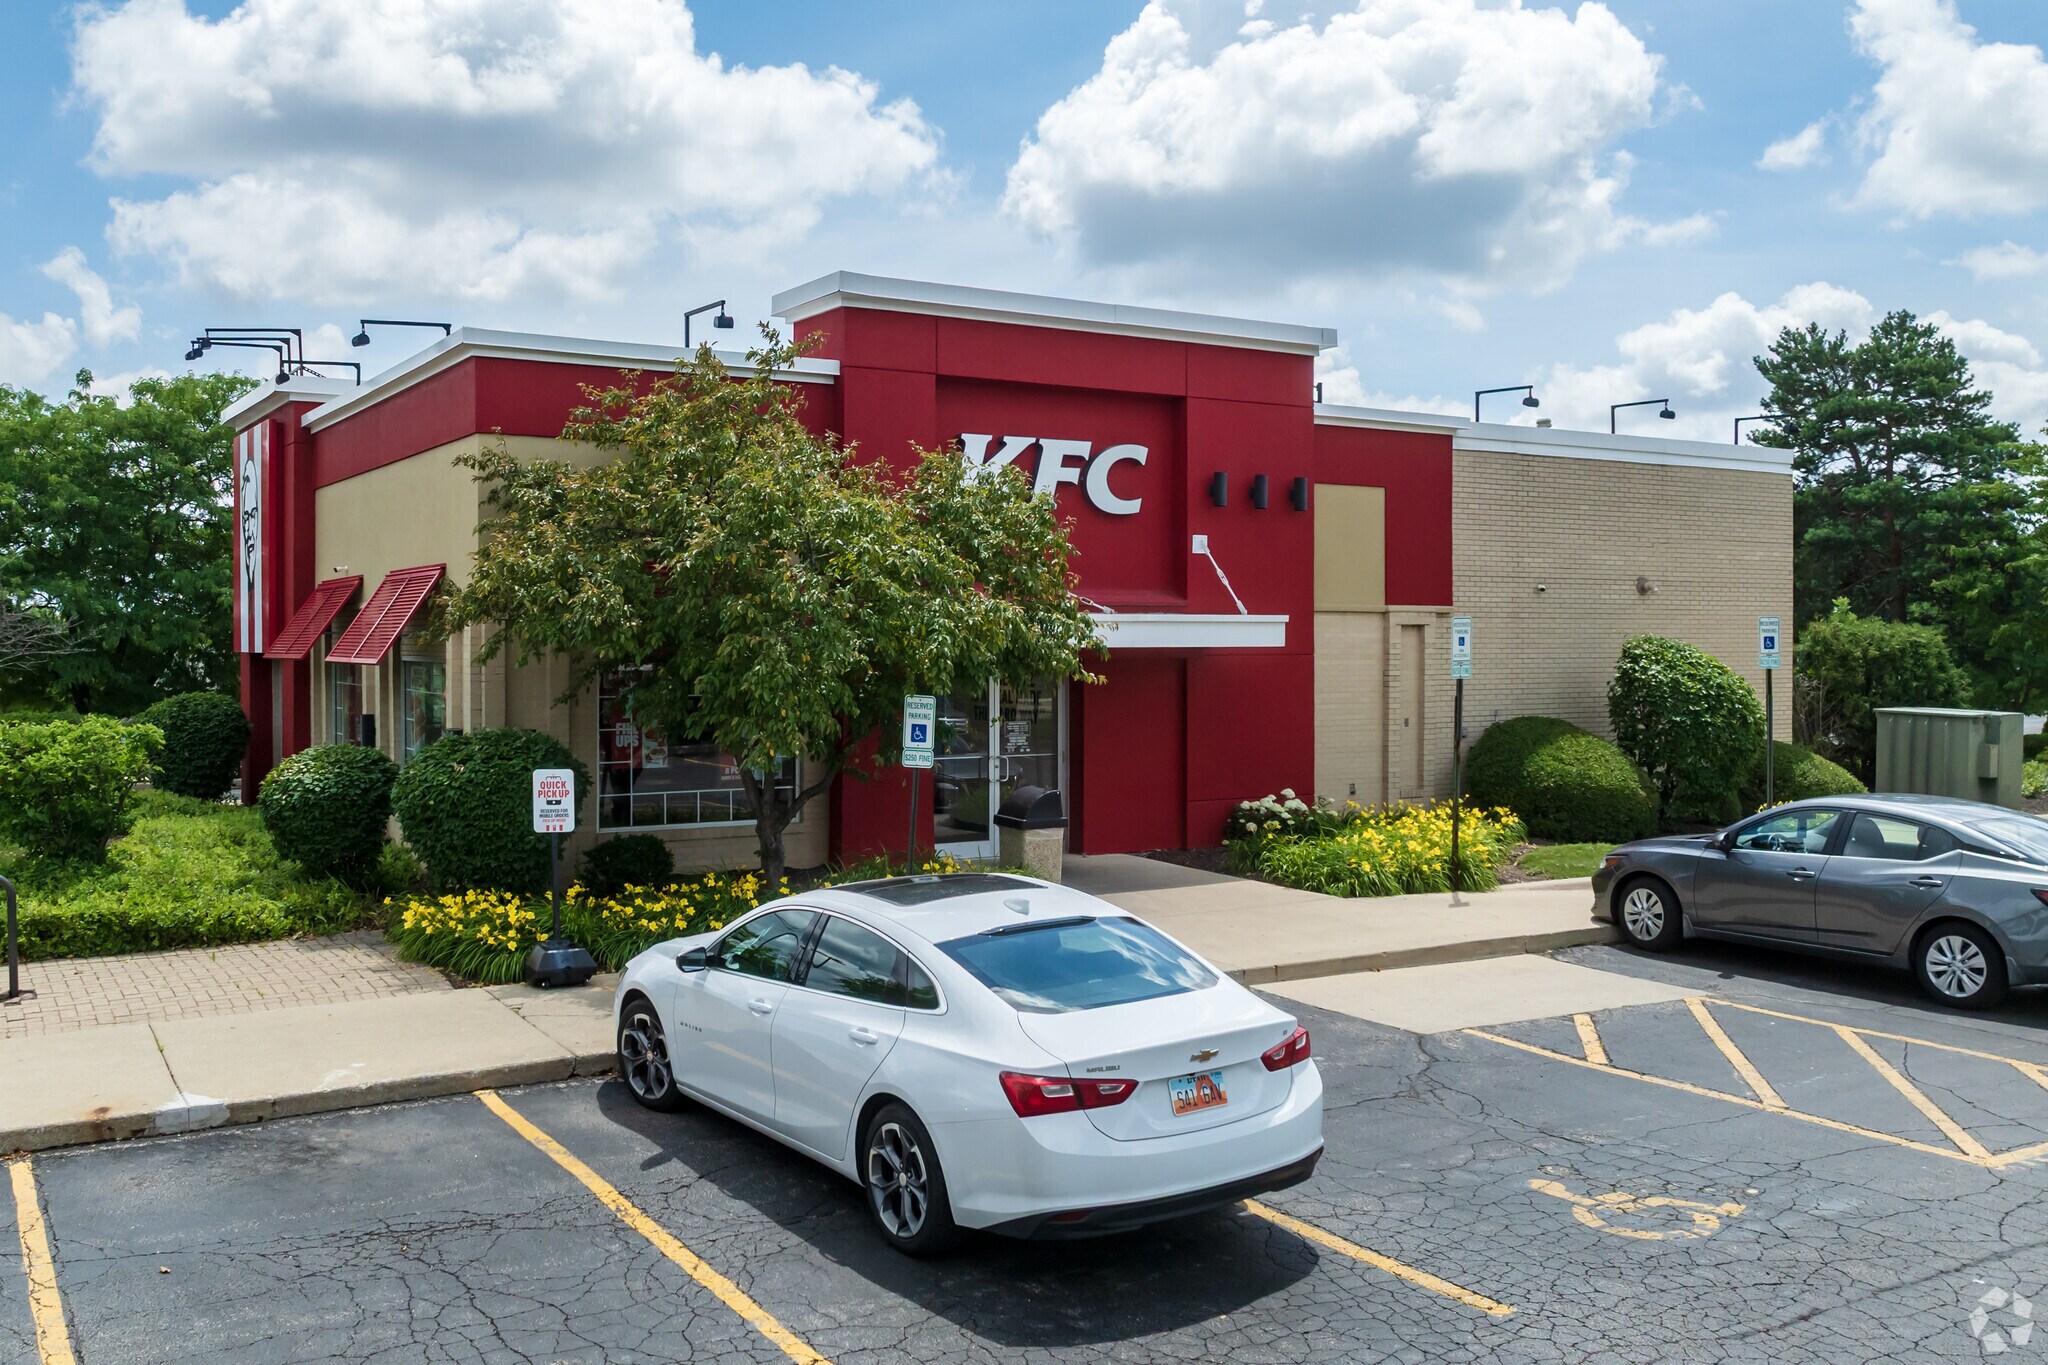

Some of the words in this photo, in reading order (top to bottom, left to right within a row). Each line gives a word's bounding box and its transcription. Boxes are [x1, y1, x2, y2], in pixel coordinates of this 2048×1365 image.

[960, 433, 1149, 515] KFC
[907, 702, 933, 710] RESERVED
[908, 712, 931, 720] PARKING
[616, 735, 639, 747] UPS
[905, 754, 917, 762] $250
[540, 781, 567, 789] QUICK
[1086, 1065, 1120, 1073] MALIBU
[1187, 1075, 1206, 1084] UTAH
